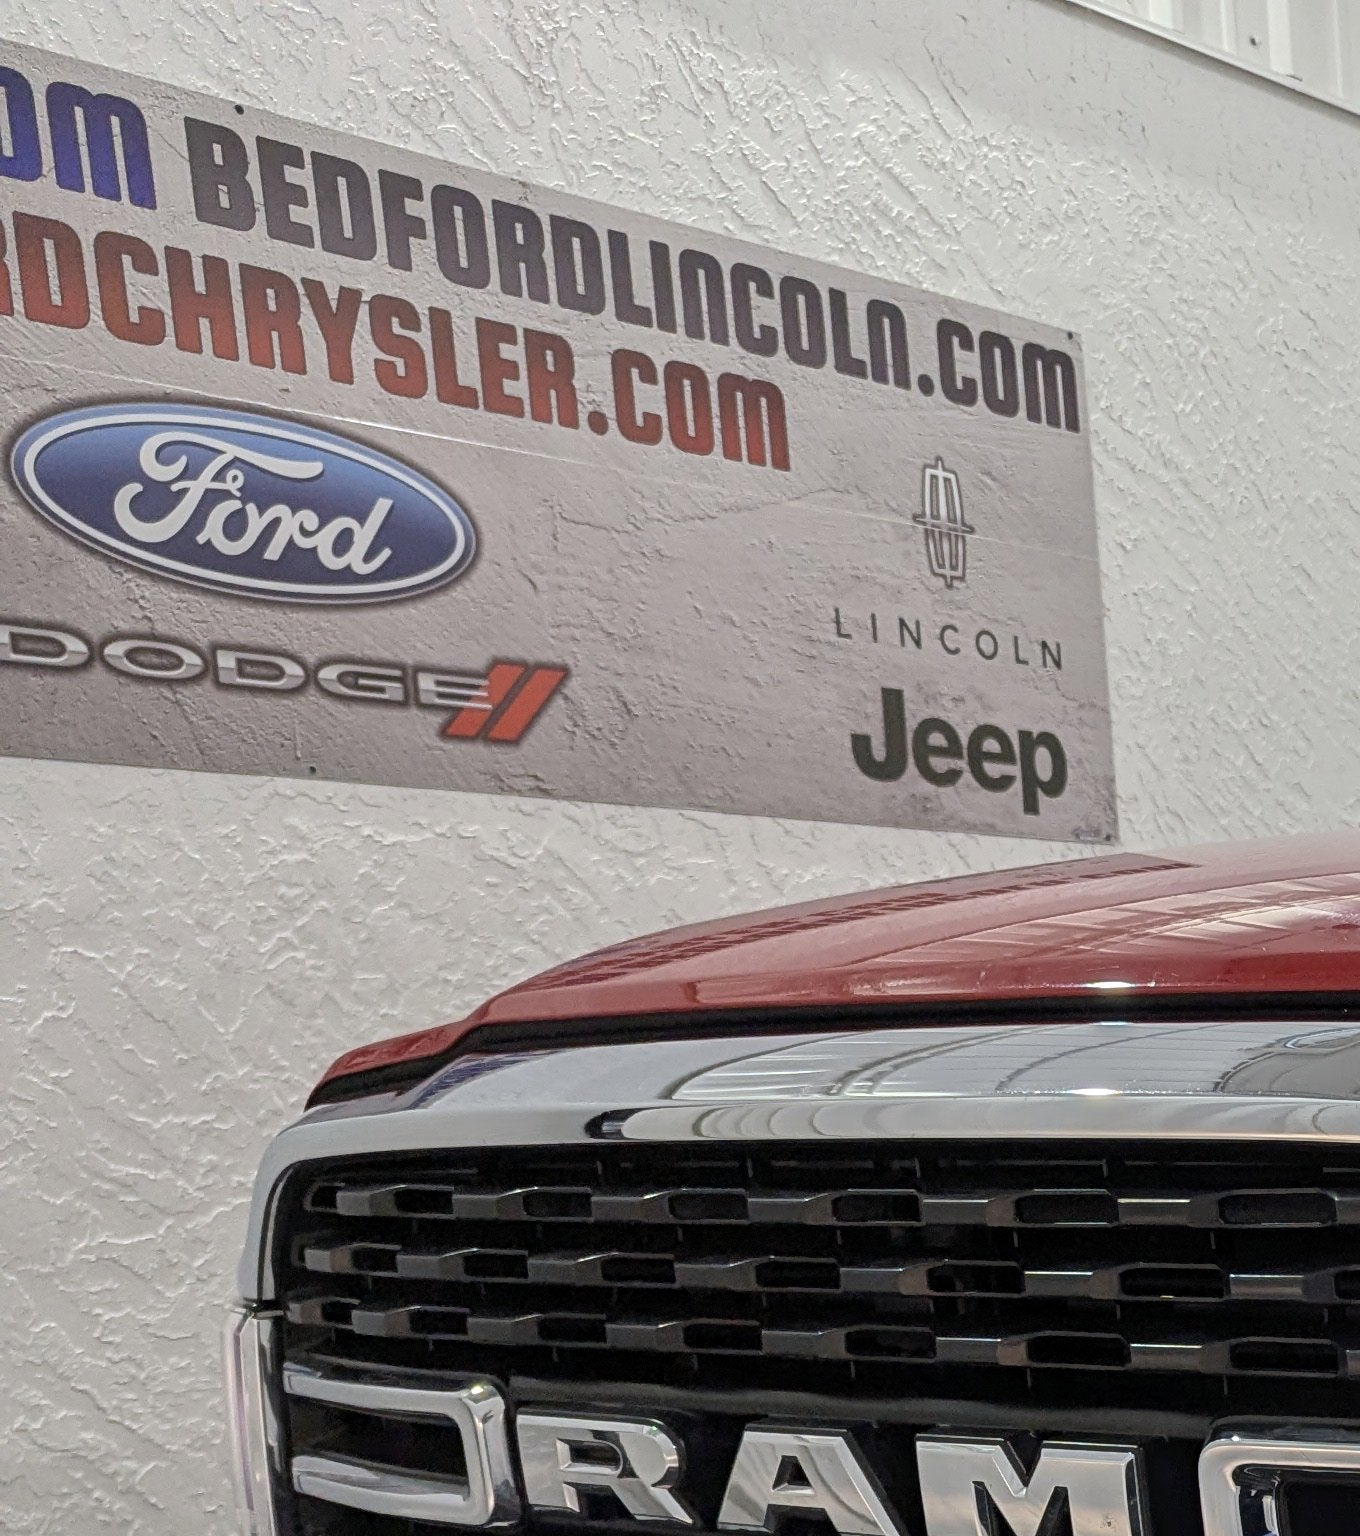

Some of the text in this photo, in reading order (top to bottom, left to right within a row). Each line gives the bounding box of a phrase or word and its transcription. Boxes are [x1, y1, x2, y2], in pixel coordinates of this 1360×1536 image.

[0, 210, 790, 472] DCHRYSLER.COM
[184, 116, 1080, 433] BEDFORDLINCOLN.COM
[113, 432, 393, 575] Ford
[0, 623, 493, 710] DODGE
[833, 607, 1063, 671] LINCOLN
[850, 687, 1069, 816] Jeep
